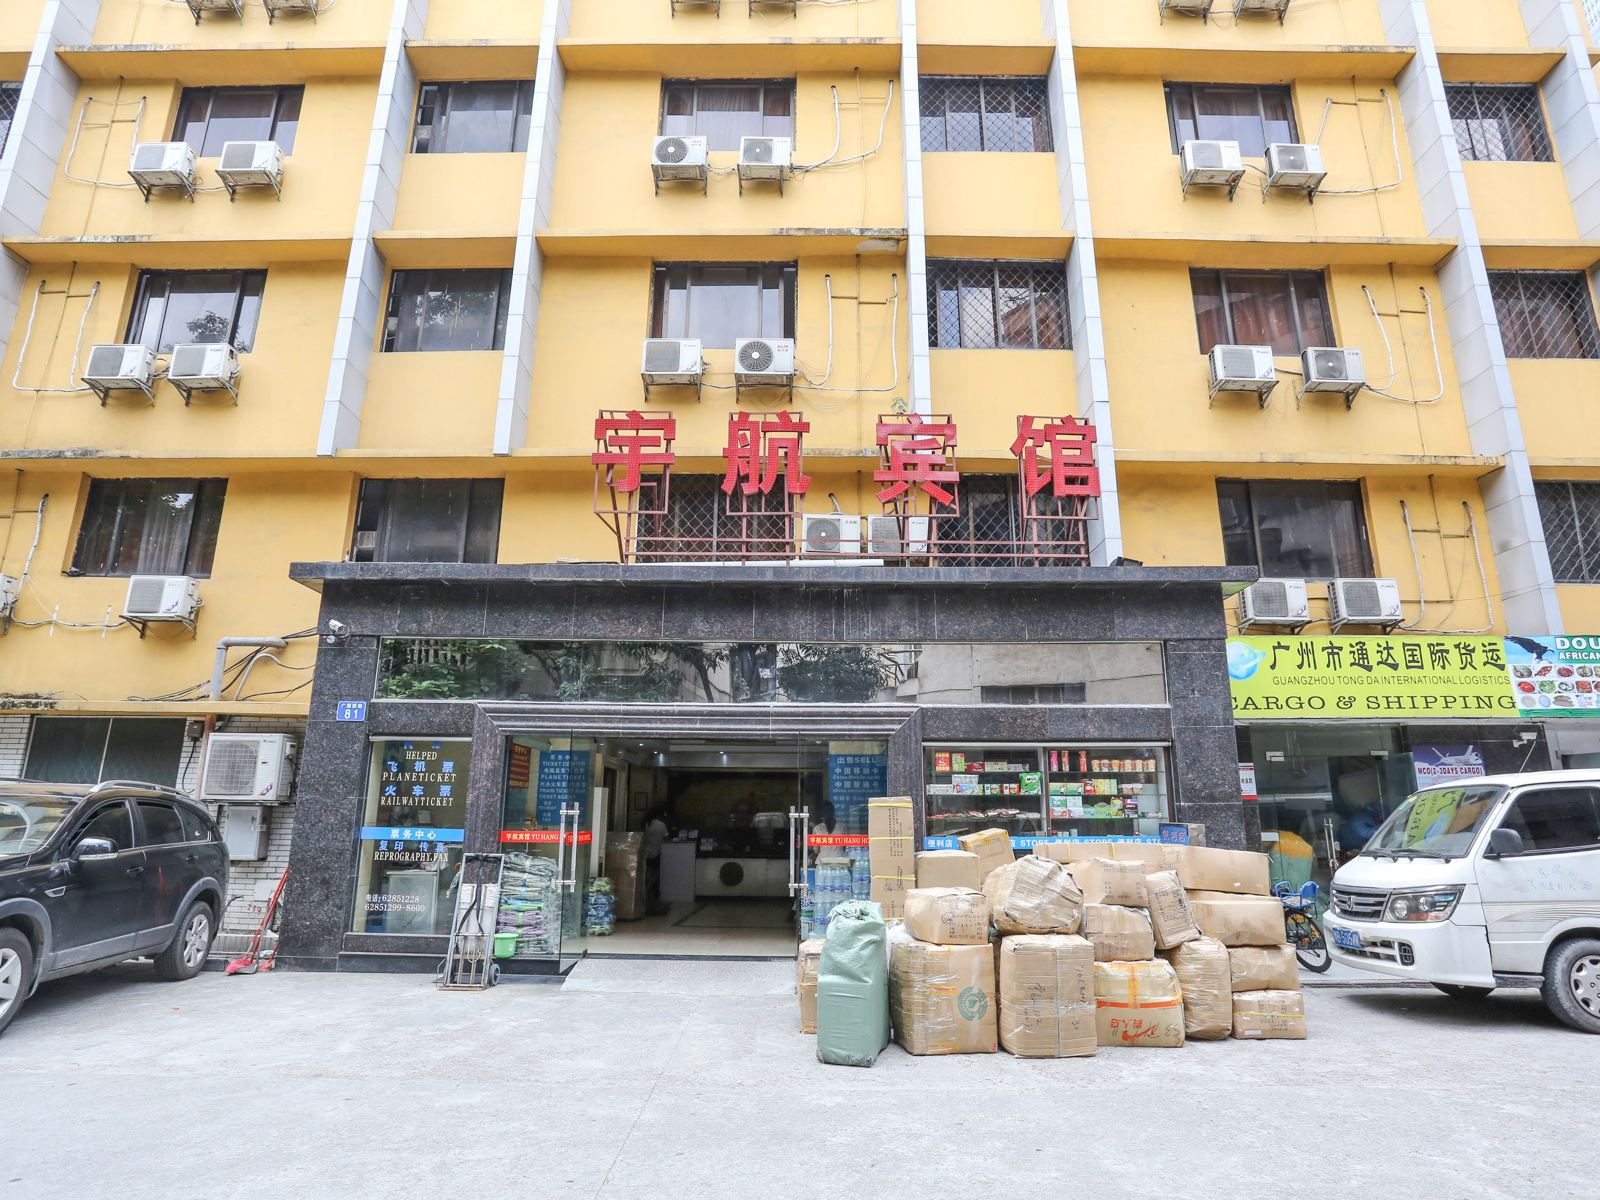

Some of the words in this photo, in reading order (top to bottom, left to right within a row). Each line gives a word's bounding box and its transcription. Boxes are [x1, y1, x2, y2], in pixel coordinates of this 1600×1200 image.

[592, 410, 1099, 506] 宇航宾馆
[1269, 640, 1505, 672] 广州市通达国际货运
[1272, 675, 1335, 686] GUANGZHOU
[1337, 675, 1364, 685] TONG
[1367, 675, 1380, 685] DA
[1381, 675, 1457, 685] INTERNATIONAL
[1460, 675, 1510, 685] LOGISTICS
[1336, 695, 1357, 710] &
[1366, 695, 1517, 710] SHIPPING
[344, 709, 359, 719] 81
[405, 751, 438, 760] HELPED
[387, 761, 455, 773] 飞机票
[382, 772, 457, 783] PLANETICKET
[384, 784, 452, 797] 火车票
[380, 796, 454, 807] RAILWAYTICKET
[389, 828, 437, 840] 票务中心
[927, 839, 953, 848] 便利店
